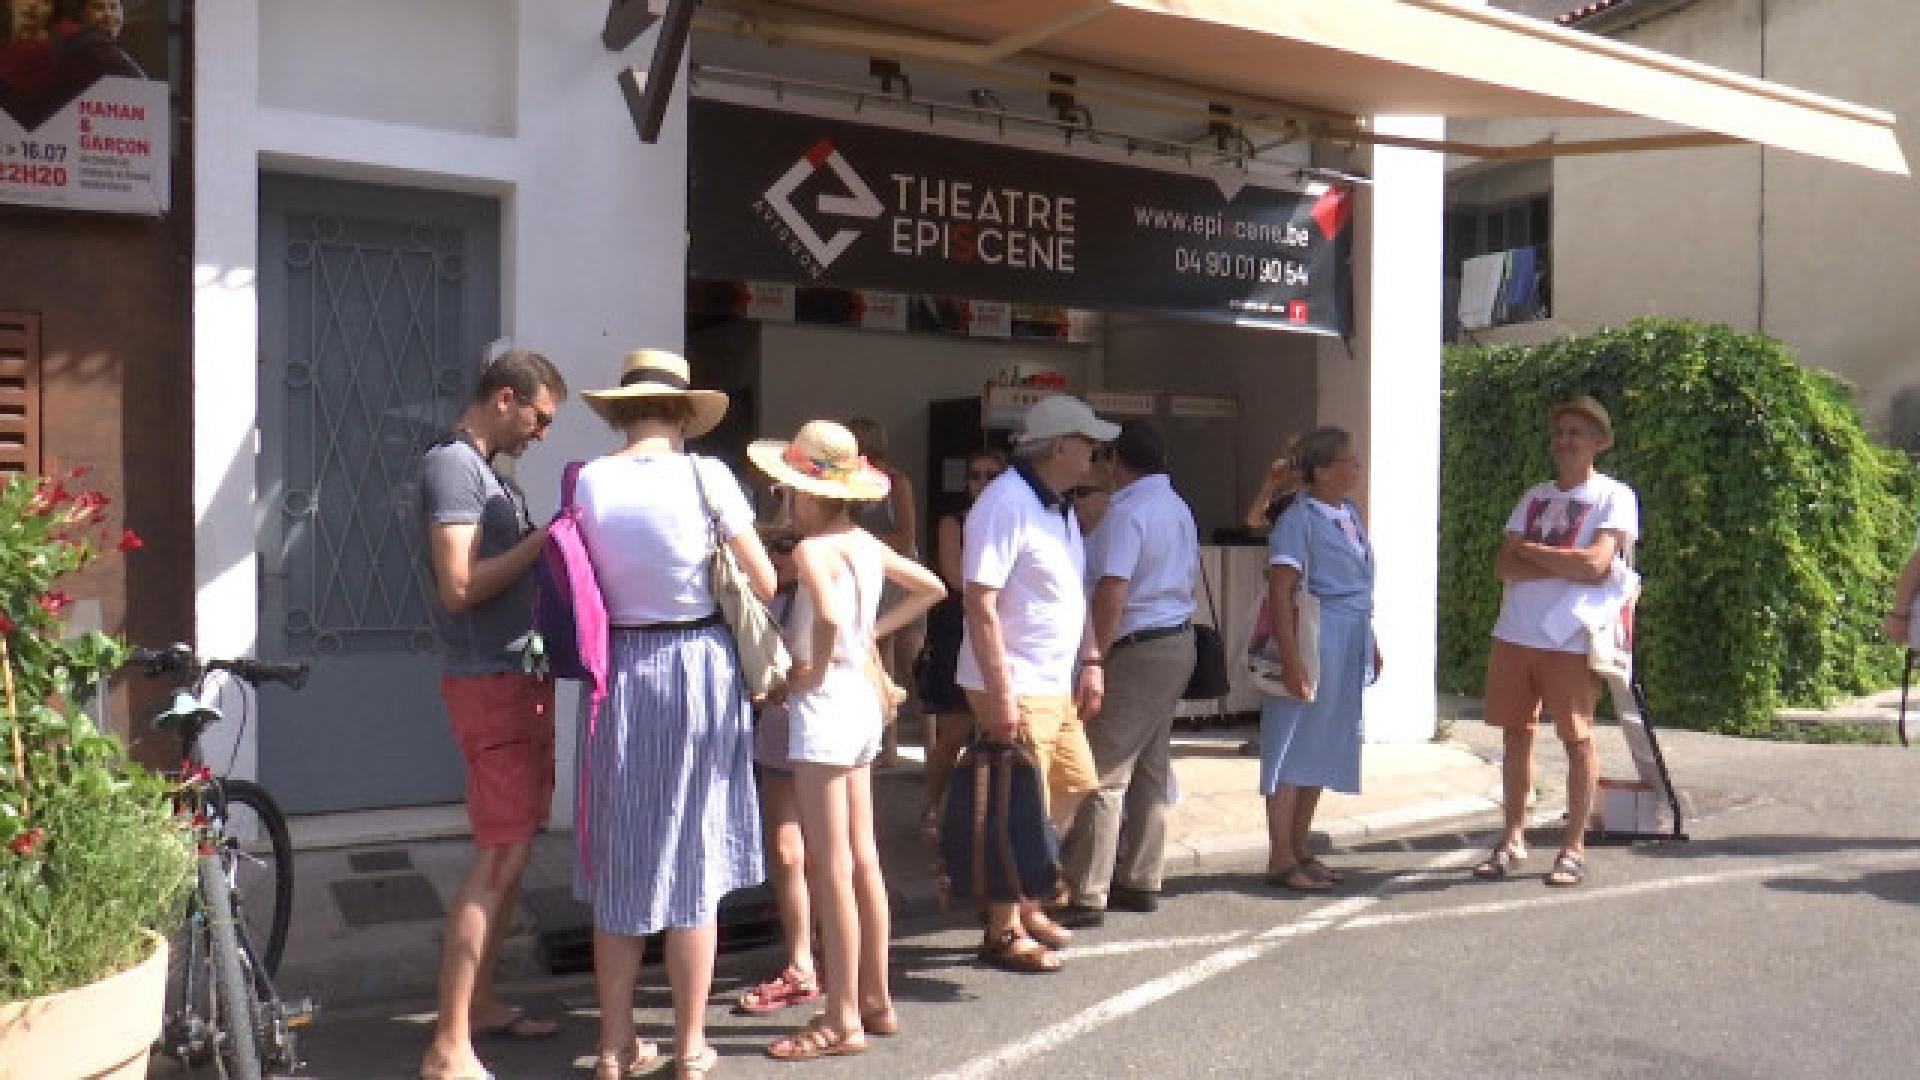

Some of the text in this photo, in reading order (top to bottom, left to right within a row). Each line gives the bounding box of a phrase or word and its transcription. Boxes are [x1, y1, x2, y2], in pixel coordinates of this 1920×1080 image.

[79, 101, 145, 121] MAMAN
[79, 117, 92, 132] &
[21, 140, 67, 162] 16.07
[891, 173, 1076, 232] THEATRE
[1134, 205, 1309, 247] www.epicene.be
[892, 216, 1076, 274] EPISCENE
[1175, 248, 1201, 274] 04
[1206, 251, 1231, 277] 90
[1236, 255, 1255, 280] 01
[1259, 257, 1282, 283] 90
